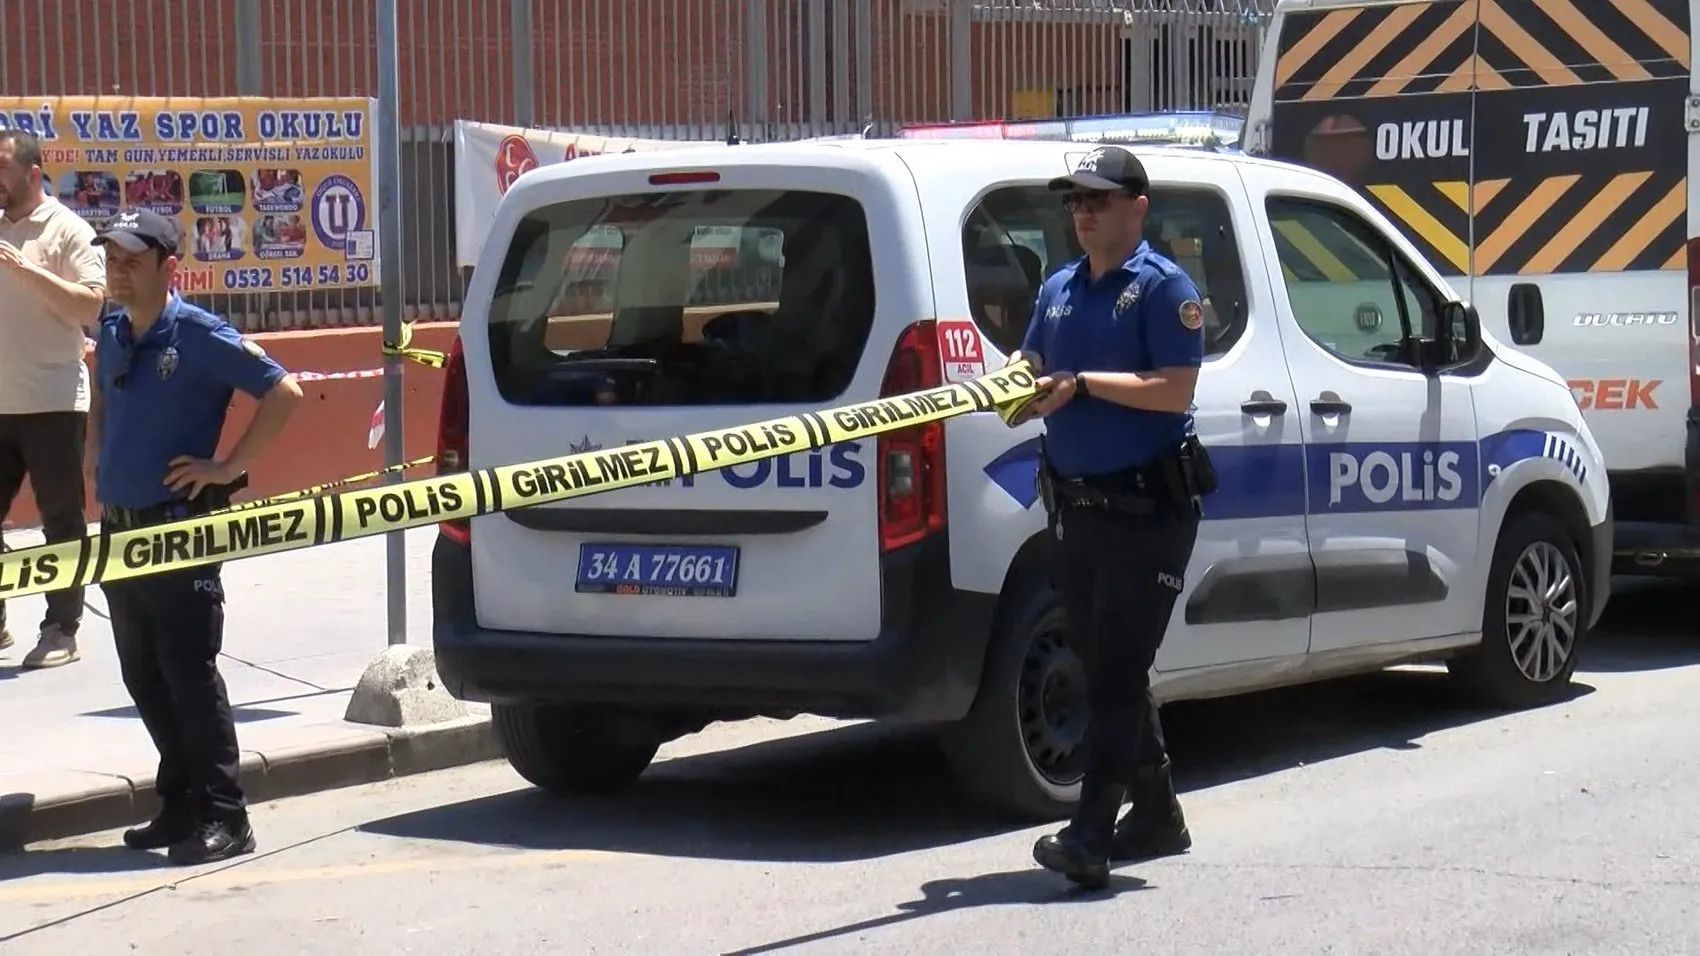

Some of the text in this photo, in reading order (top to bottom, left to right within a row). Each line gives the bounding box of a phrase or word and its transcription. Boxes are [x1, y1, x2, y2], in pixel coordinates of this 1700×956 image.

[71, 112, 140, 139] YAZ
[156, 112, 244, 139] SPOR
[260, 112, 363, 138] OKULU
[1376, 119, 1470, 160] OKUL
[86, 149, 118, 163] TAM
[296, 147, 319, 160] YAZ
[321, 147, 363, 160] OKULU
[224, 268, 273, 289] 0532
[281, 266, 313, 287] 514
[318, 264, 341, 284] 54
[346, 263, 369, 283] 30
[945, 328, 977, 358] 112
[587, 552, 725, 583] 34 A 77661
